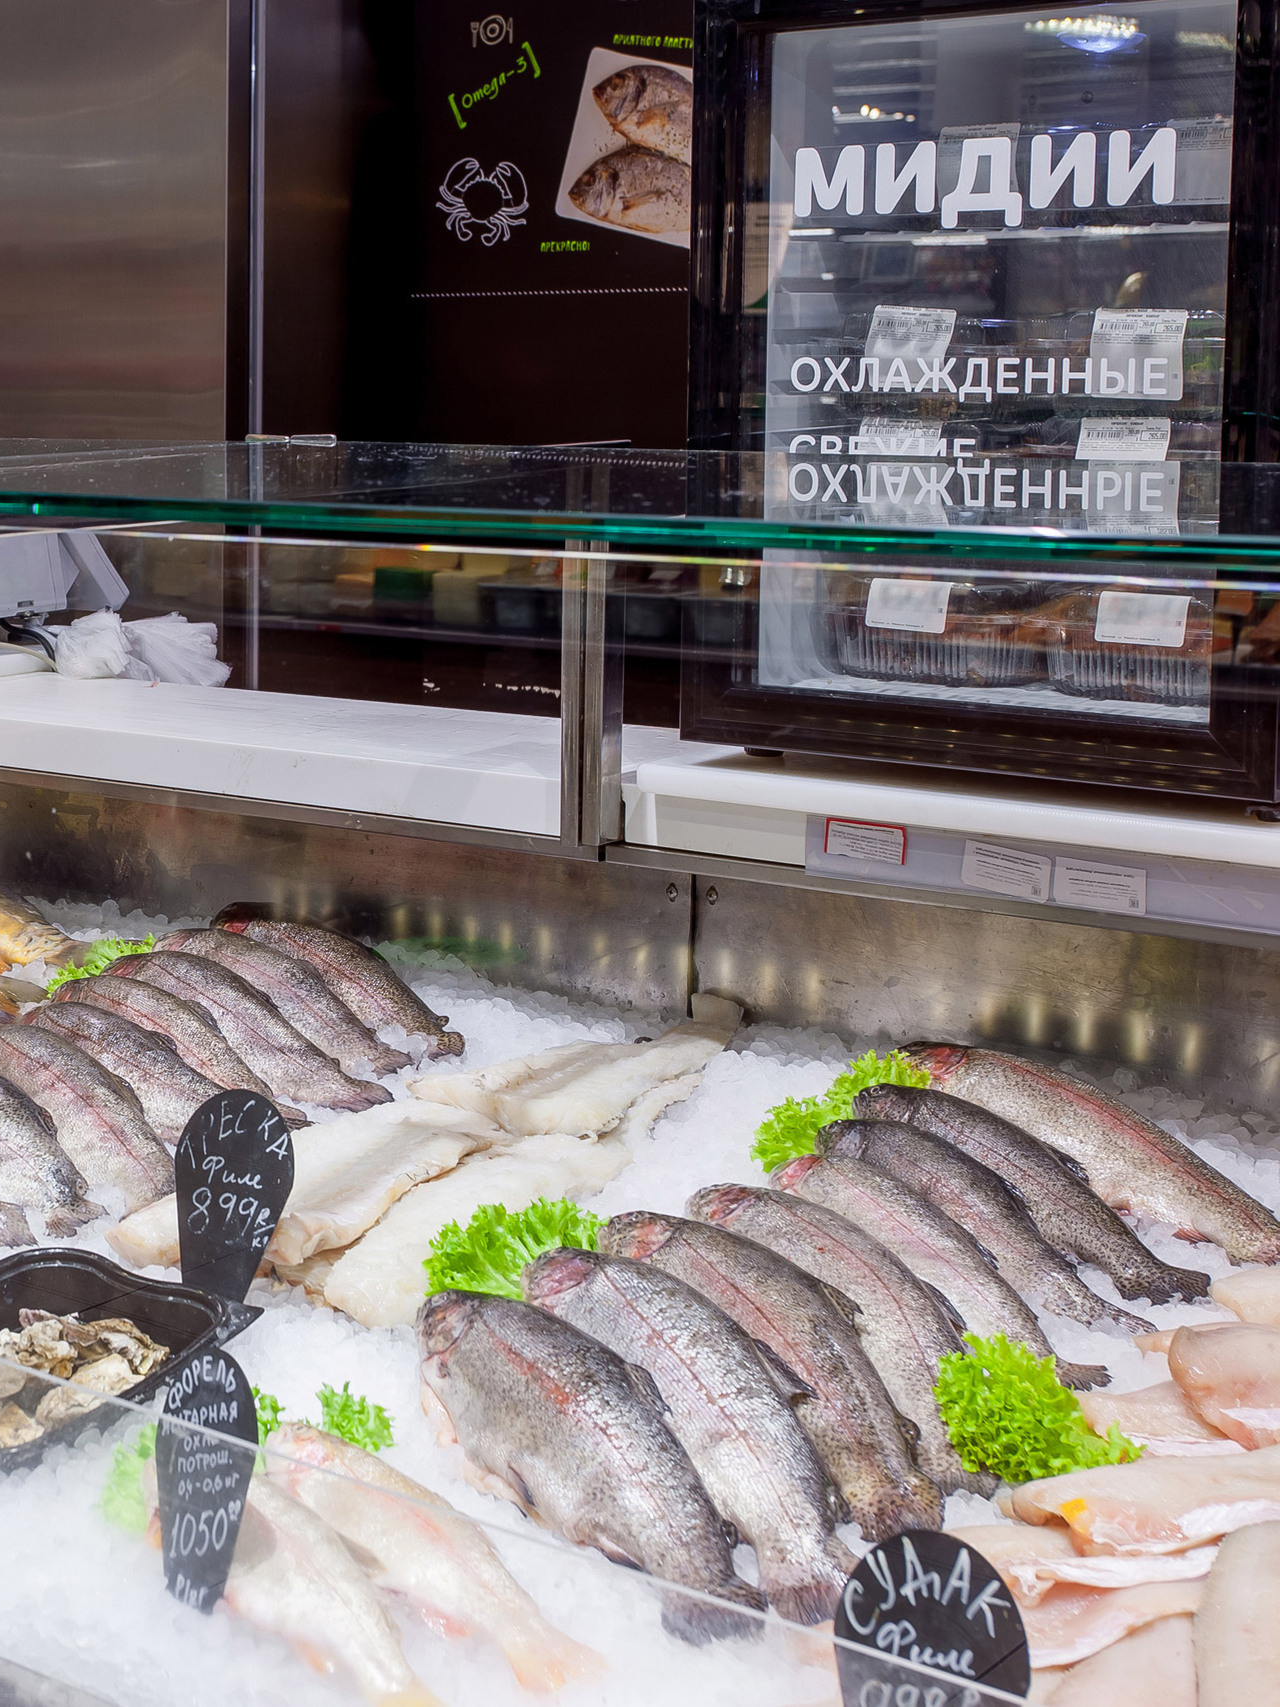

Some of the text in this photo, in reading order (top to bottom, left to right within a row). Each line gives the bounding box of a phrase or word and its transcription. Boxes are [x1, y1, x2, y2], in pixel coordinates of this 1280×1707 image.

[794, 127, 1177, 229] МИДИИ
[789, 356, 1169, 403] ОХЛАЖДЕННЫЕ
[180, 1099, 289, 1169] ТРЕСКА
[168, 1355, 237, 1410] ФОРЕЛЬ
[843, 1535, 1012, 1639] СУДАК
